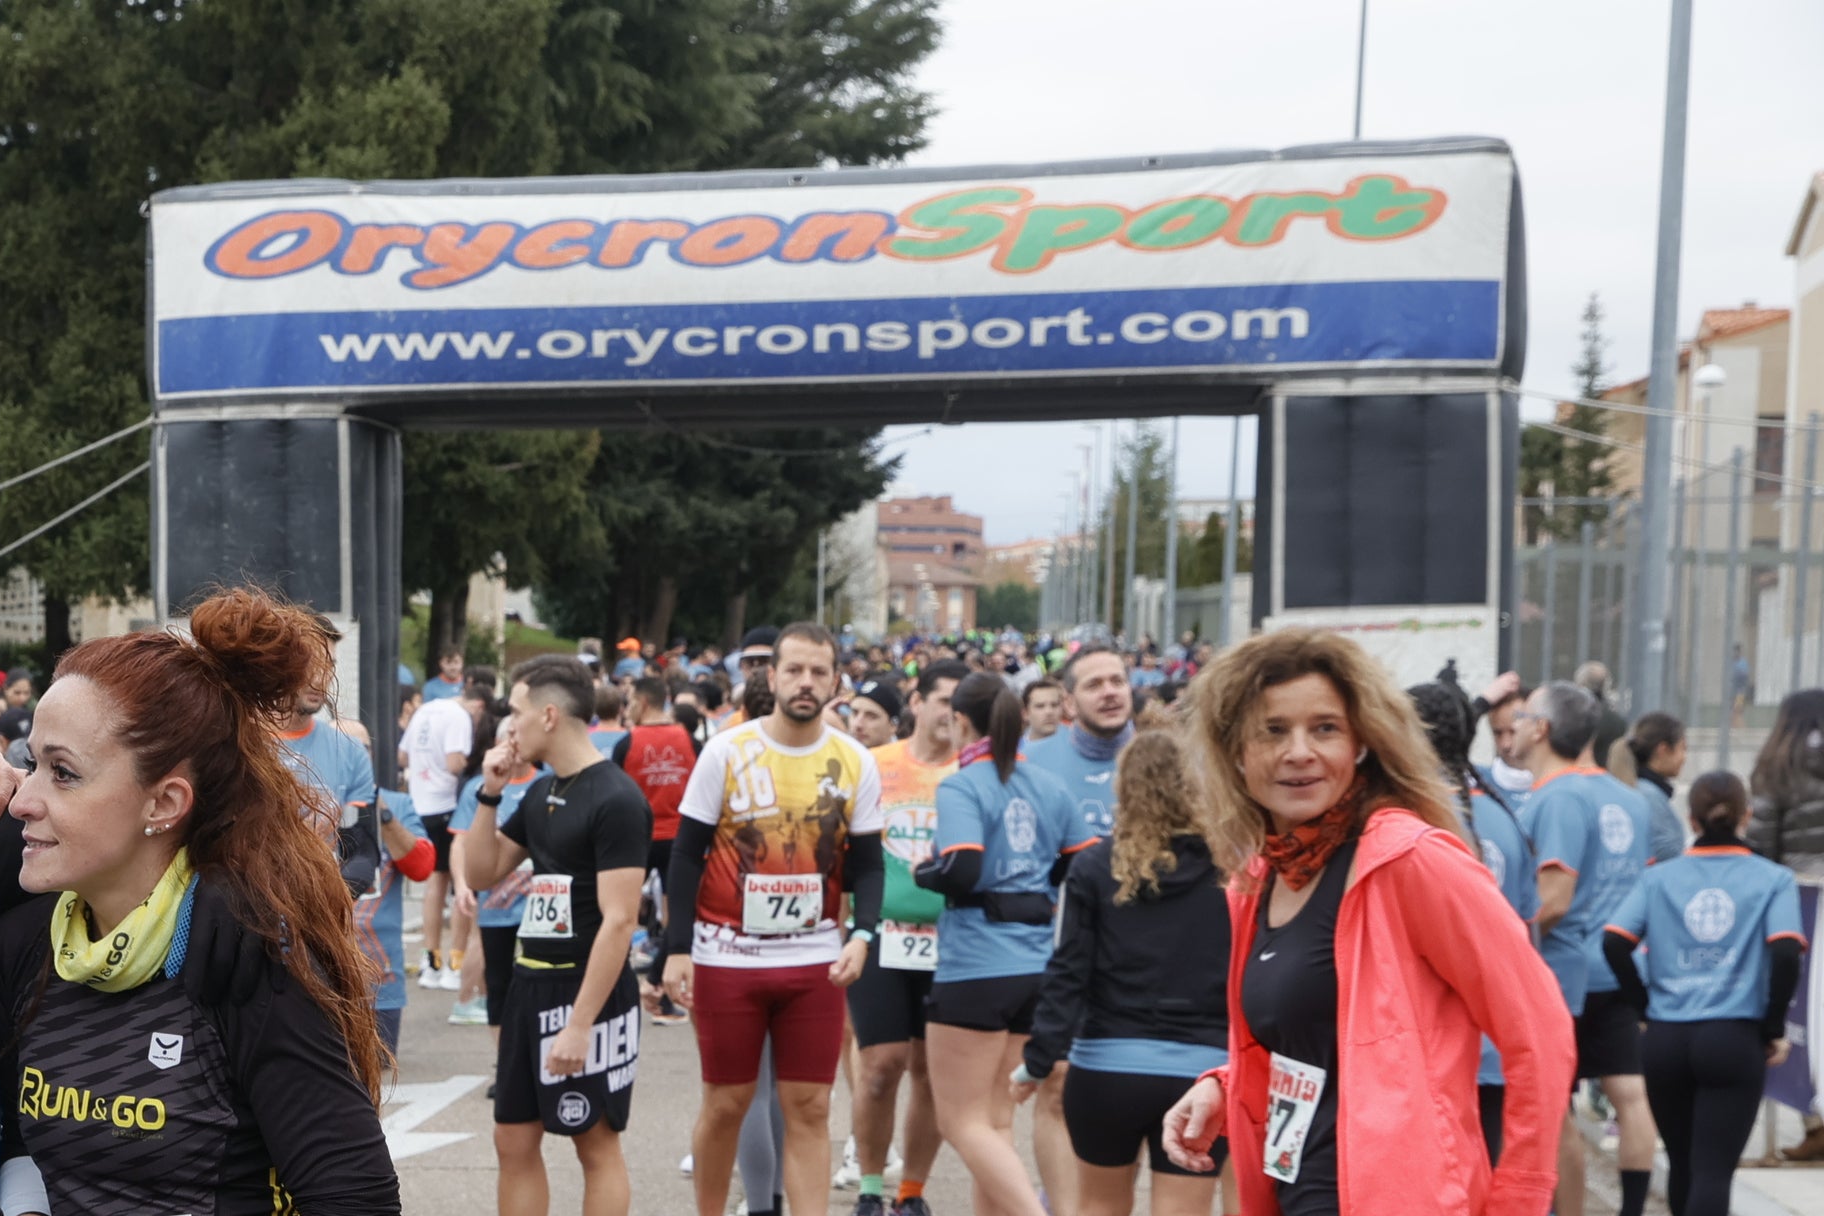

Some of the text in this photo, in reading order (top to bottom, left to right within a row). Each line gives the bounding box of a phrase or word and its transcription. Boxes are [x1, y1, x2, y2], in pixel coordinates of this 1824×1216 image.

[203, 174, 1447, 289] OrycronSport
[319, 306, 1310, 366] www.orycronsport.com
[748, 879, 819, 894] bedunia
[529, 897, 558, 922] 136
[768, 896, 801, 919] 74
[106, 932, 130, 966] GO
[903, 936, 932, 957] 92
[20, 1066, 166, 1130] RUN & GO
[1266, 1094, 1297, 1147] 7
